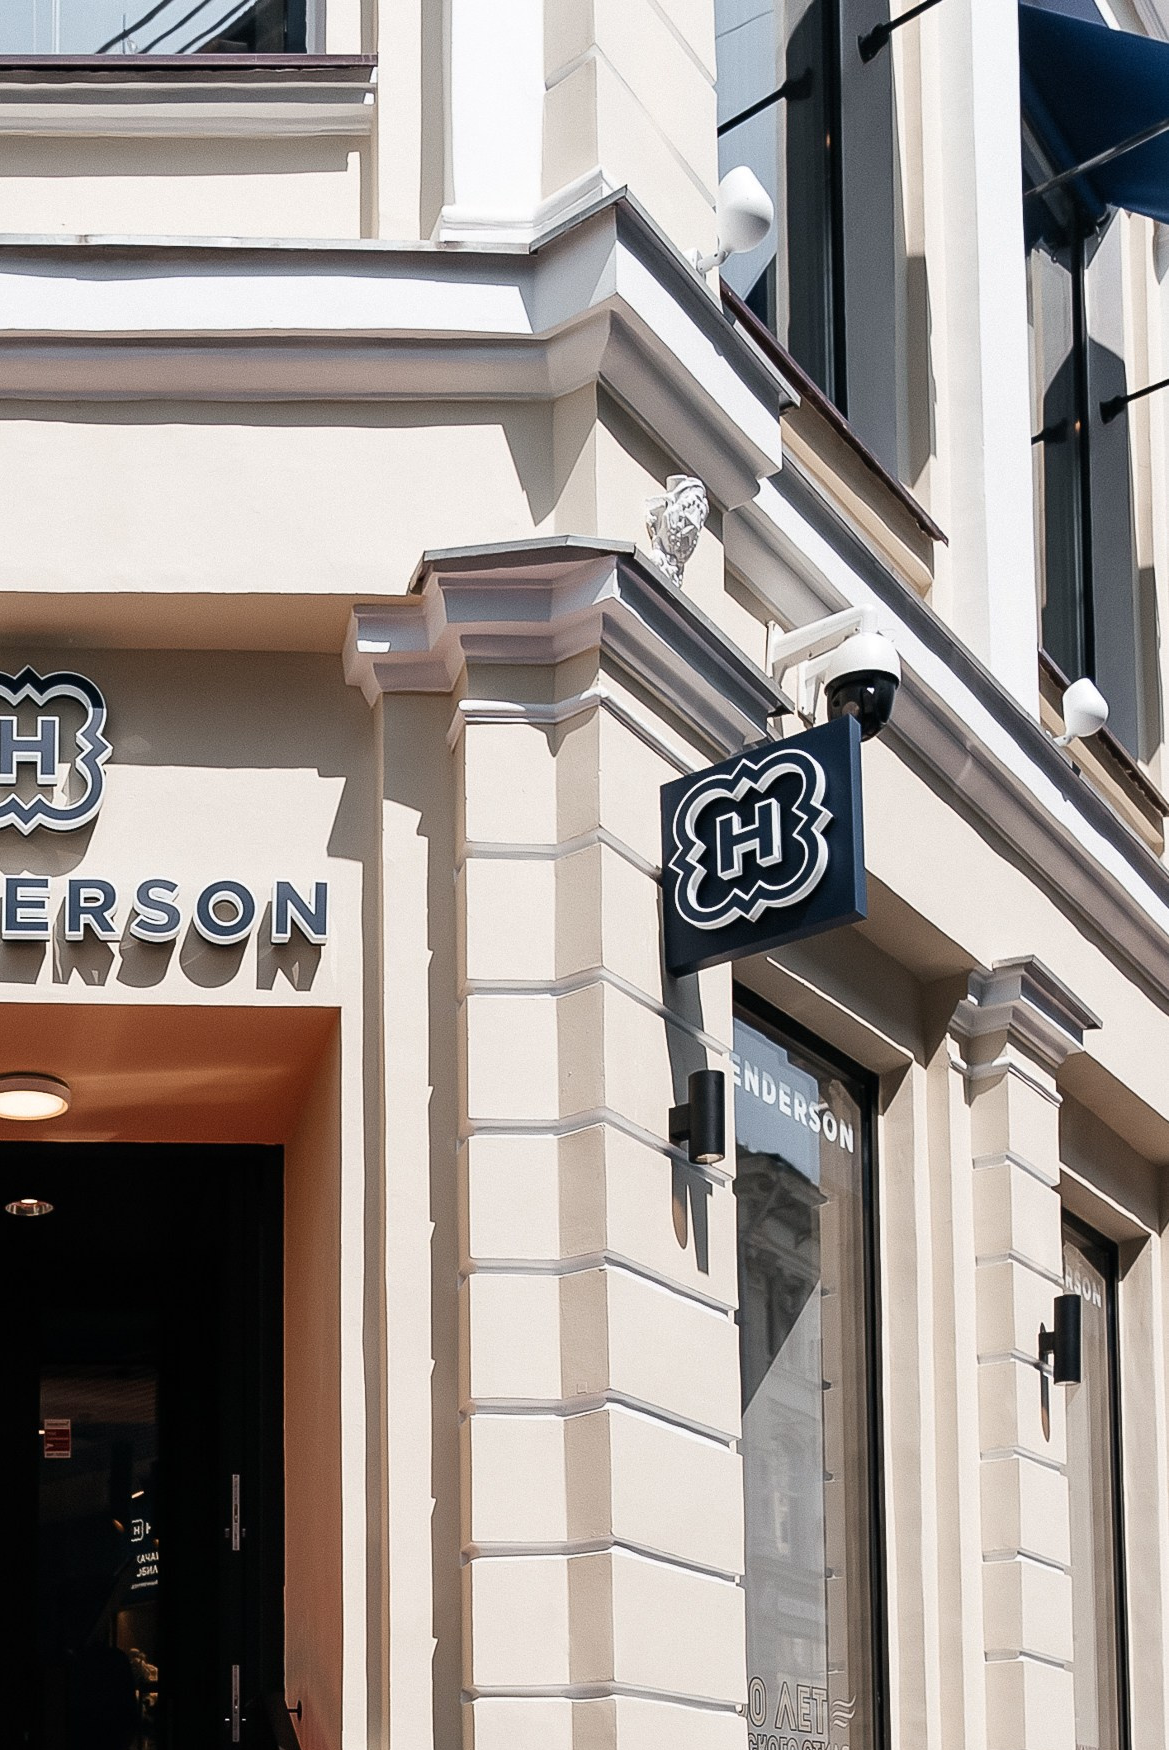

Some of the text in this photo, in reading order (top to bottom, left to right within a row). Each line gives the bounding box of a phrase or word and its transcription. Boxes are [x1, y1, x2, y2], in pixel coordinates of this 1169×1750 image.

[716, 797, 782, 880] H
[729, 1052, 854, 1153] ENDERSON
[774, 1681, 828, 1735] ЛЕТ
